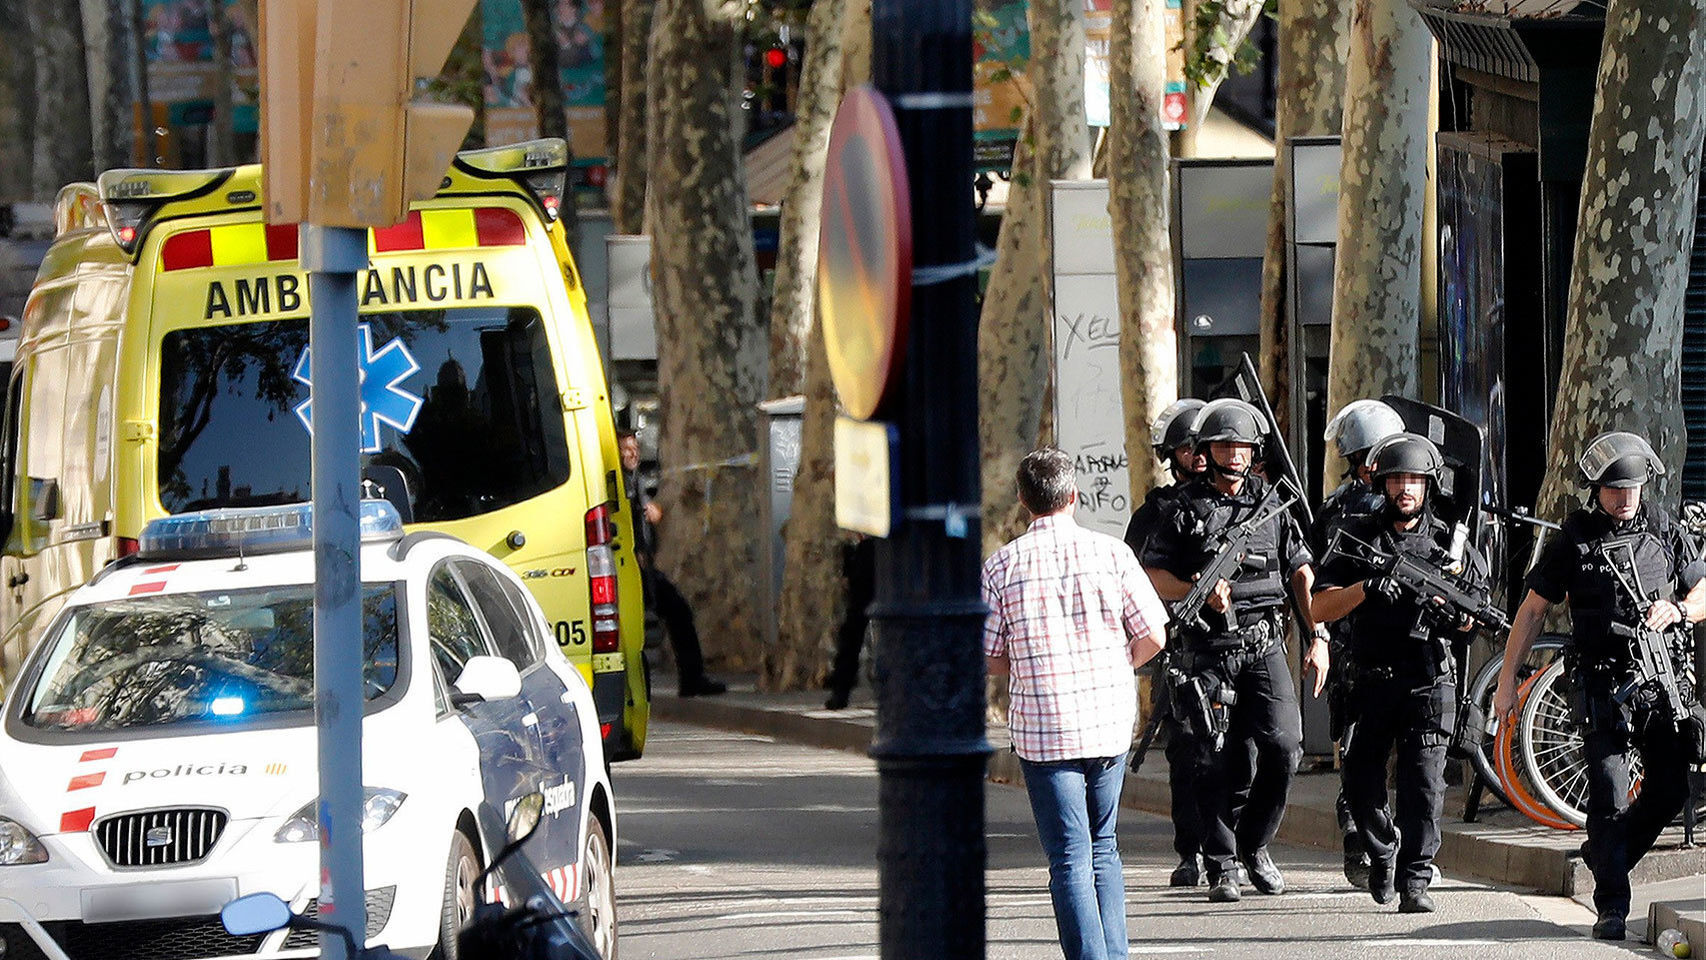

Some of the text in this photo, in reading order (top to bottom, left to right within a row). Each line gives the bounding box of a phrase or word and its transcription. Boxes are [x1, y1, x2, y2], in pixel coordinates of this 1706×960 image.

[204, 260, 495, 320] AMBÀNCIA
[551, 566, 576, 578] CDI
[548, 619, 587, 647] 05
[122, 762, 248, 786] policia
